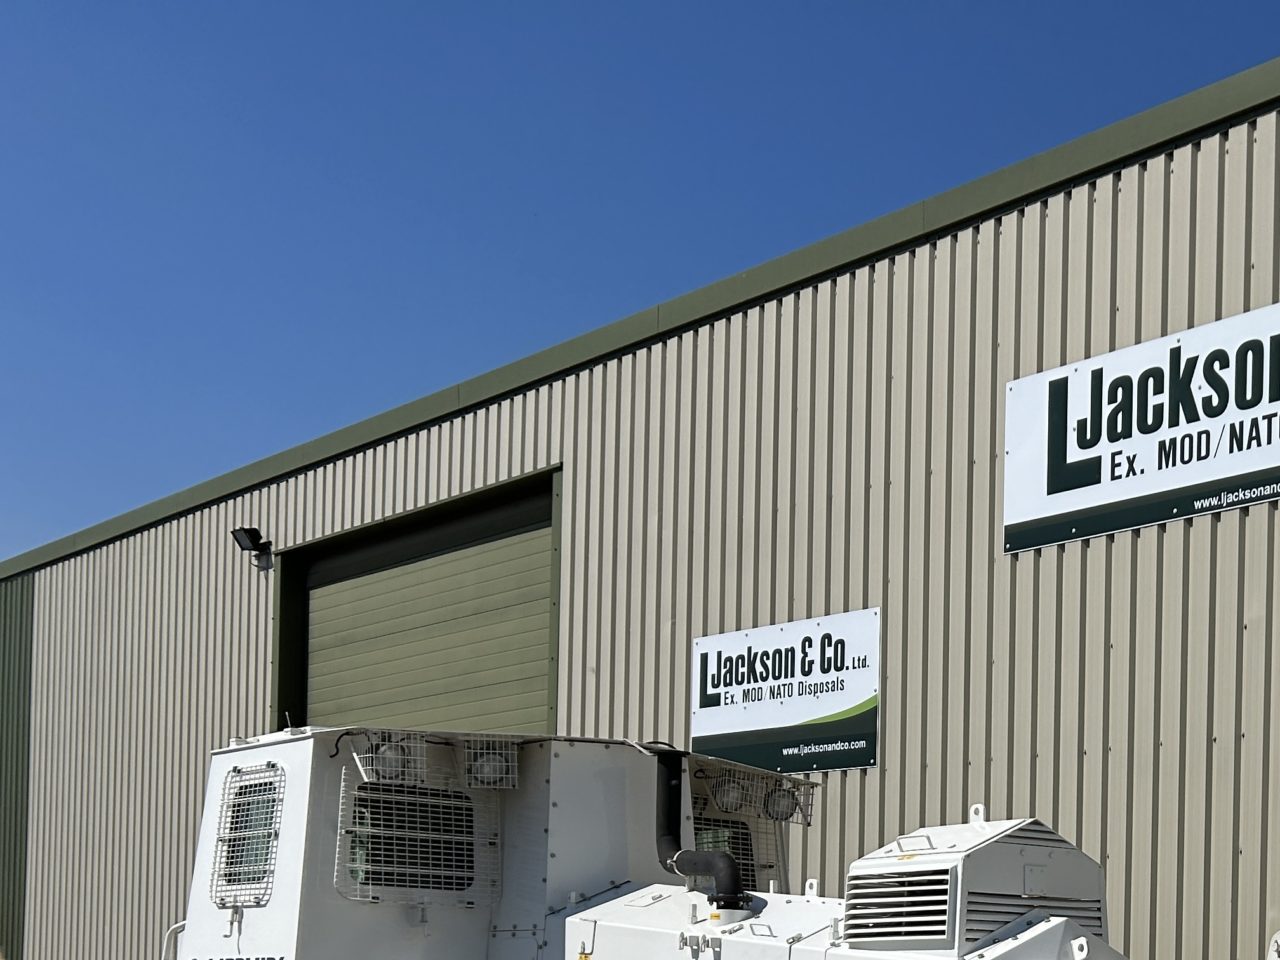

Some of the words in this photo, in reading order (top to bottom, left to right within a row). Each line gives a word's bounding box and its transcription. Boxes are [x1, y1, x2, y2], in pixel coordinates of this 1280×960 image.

[1111, 451, 1144, 480] Ex.
[801, 636, 814, 677] &
[820, 633, 849, 674] Co.
[852, 655, 870, 669] Ltd.
[724, 692, 738, 705] Ex.
[742, 682, 794, 703] MOD/NATO
[798, 676, 845, 697] Disposals
[782, 740, 866, 756] www.ljacksonandco.com
